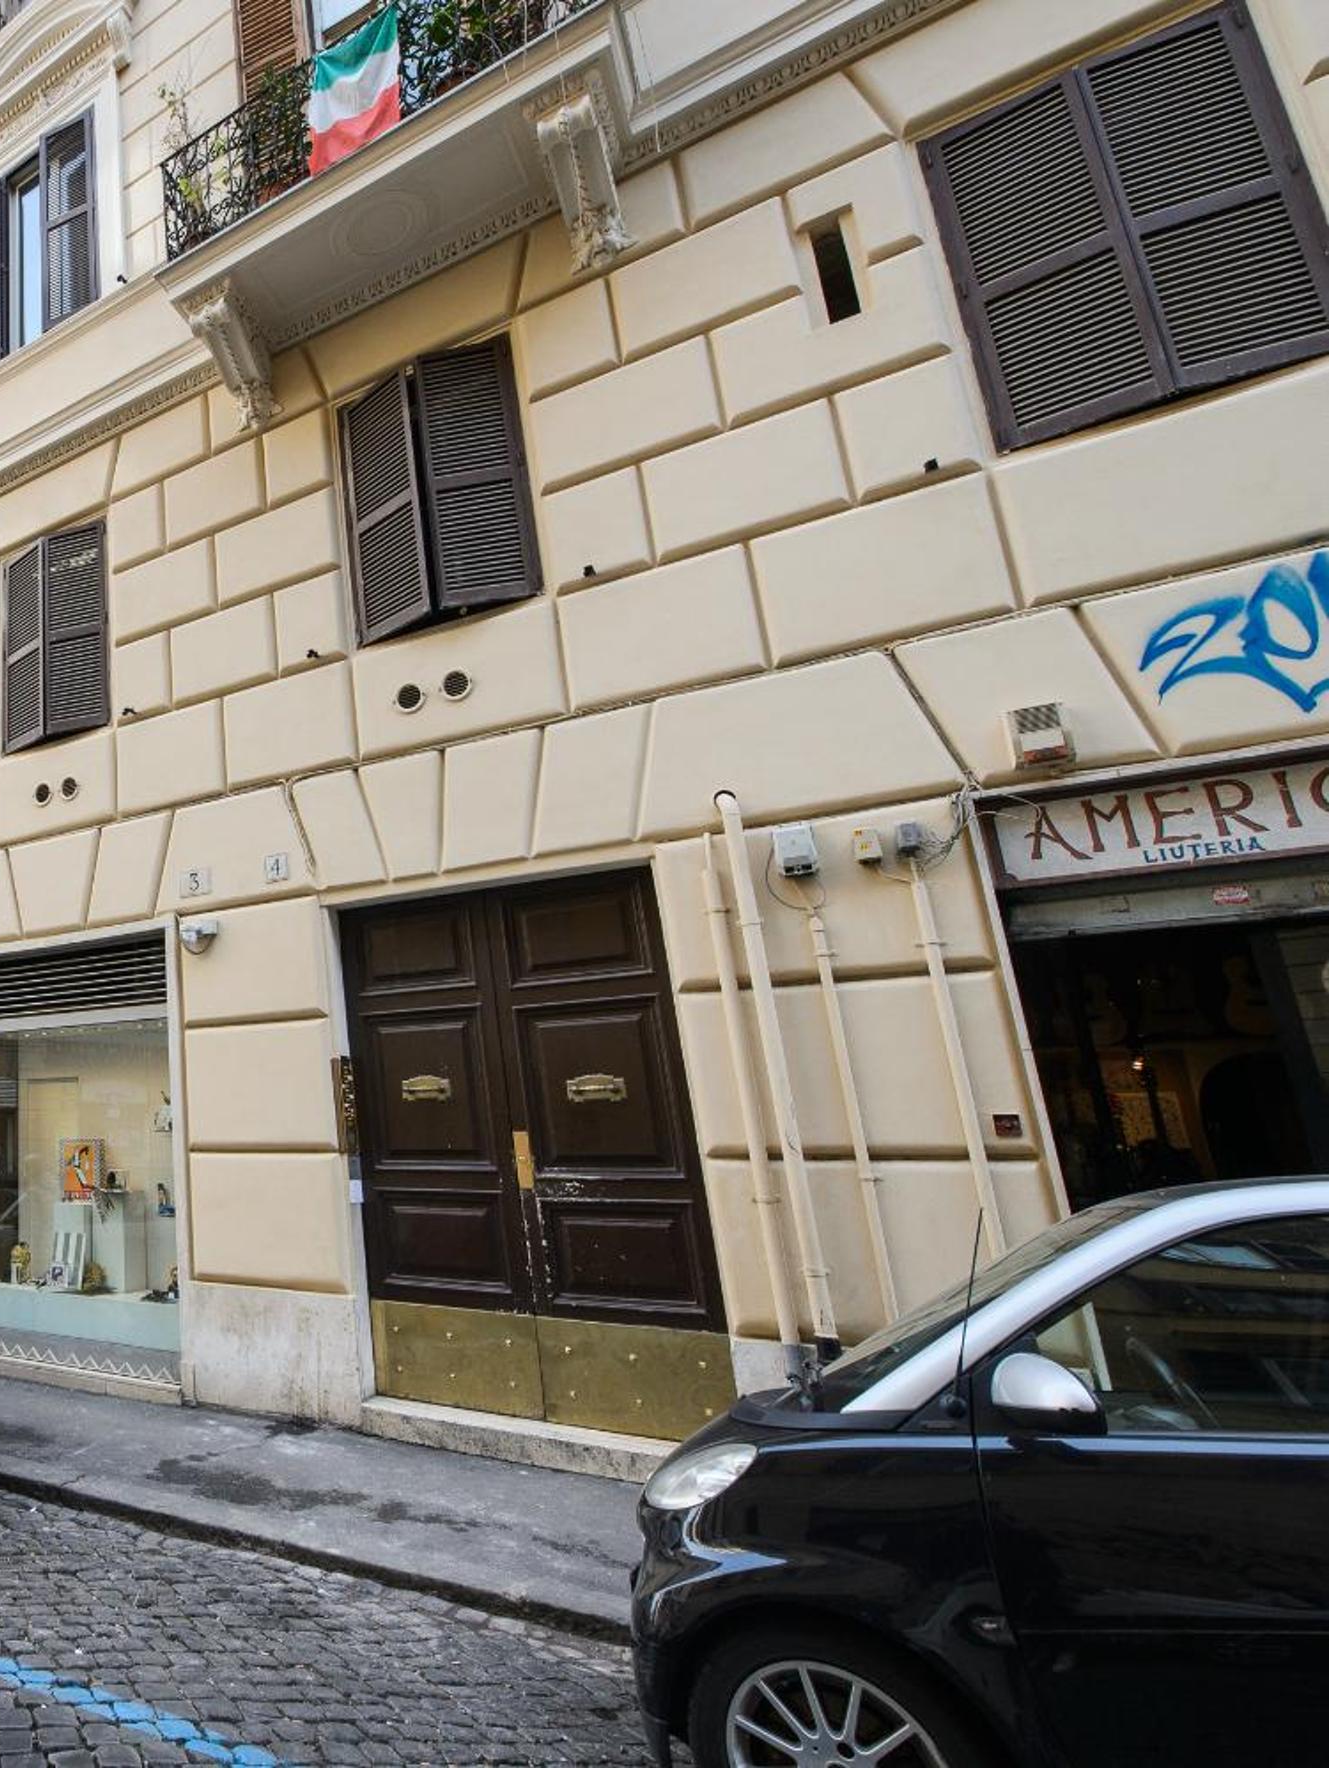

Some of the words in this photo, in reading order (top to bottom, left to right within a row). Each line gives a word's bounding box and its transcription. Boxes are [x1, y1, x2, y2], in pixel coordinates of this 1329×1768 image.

[1143, 836, 1267, 864] LIUTERIA
[270, 858, 280, 876] 4
[189, 872, 200, 892] 3
